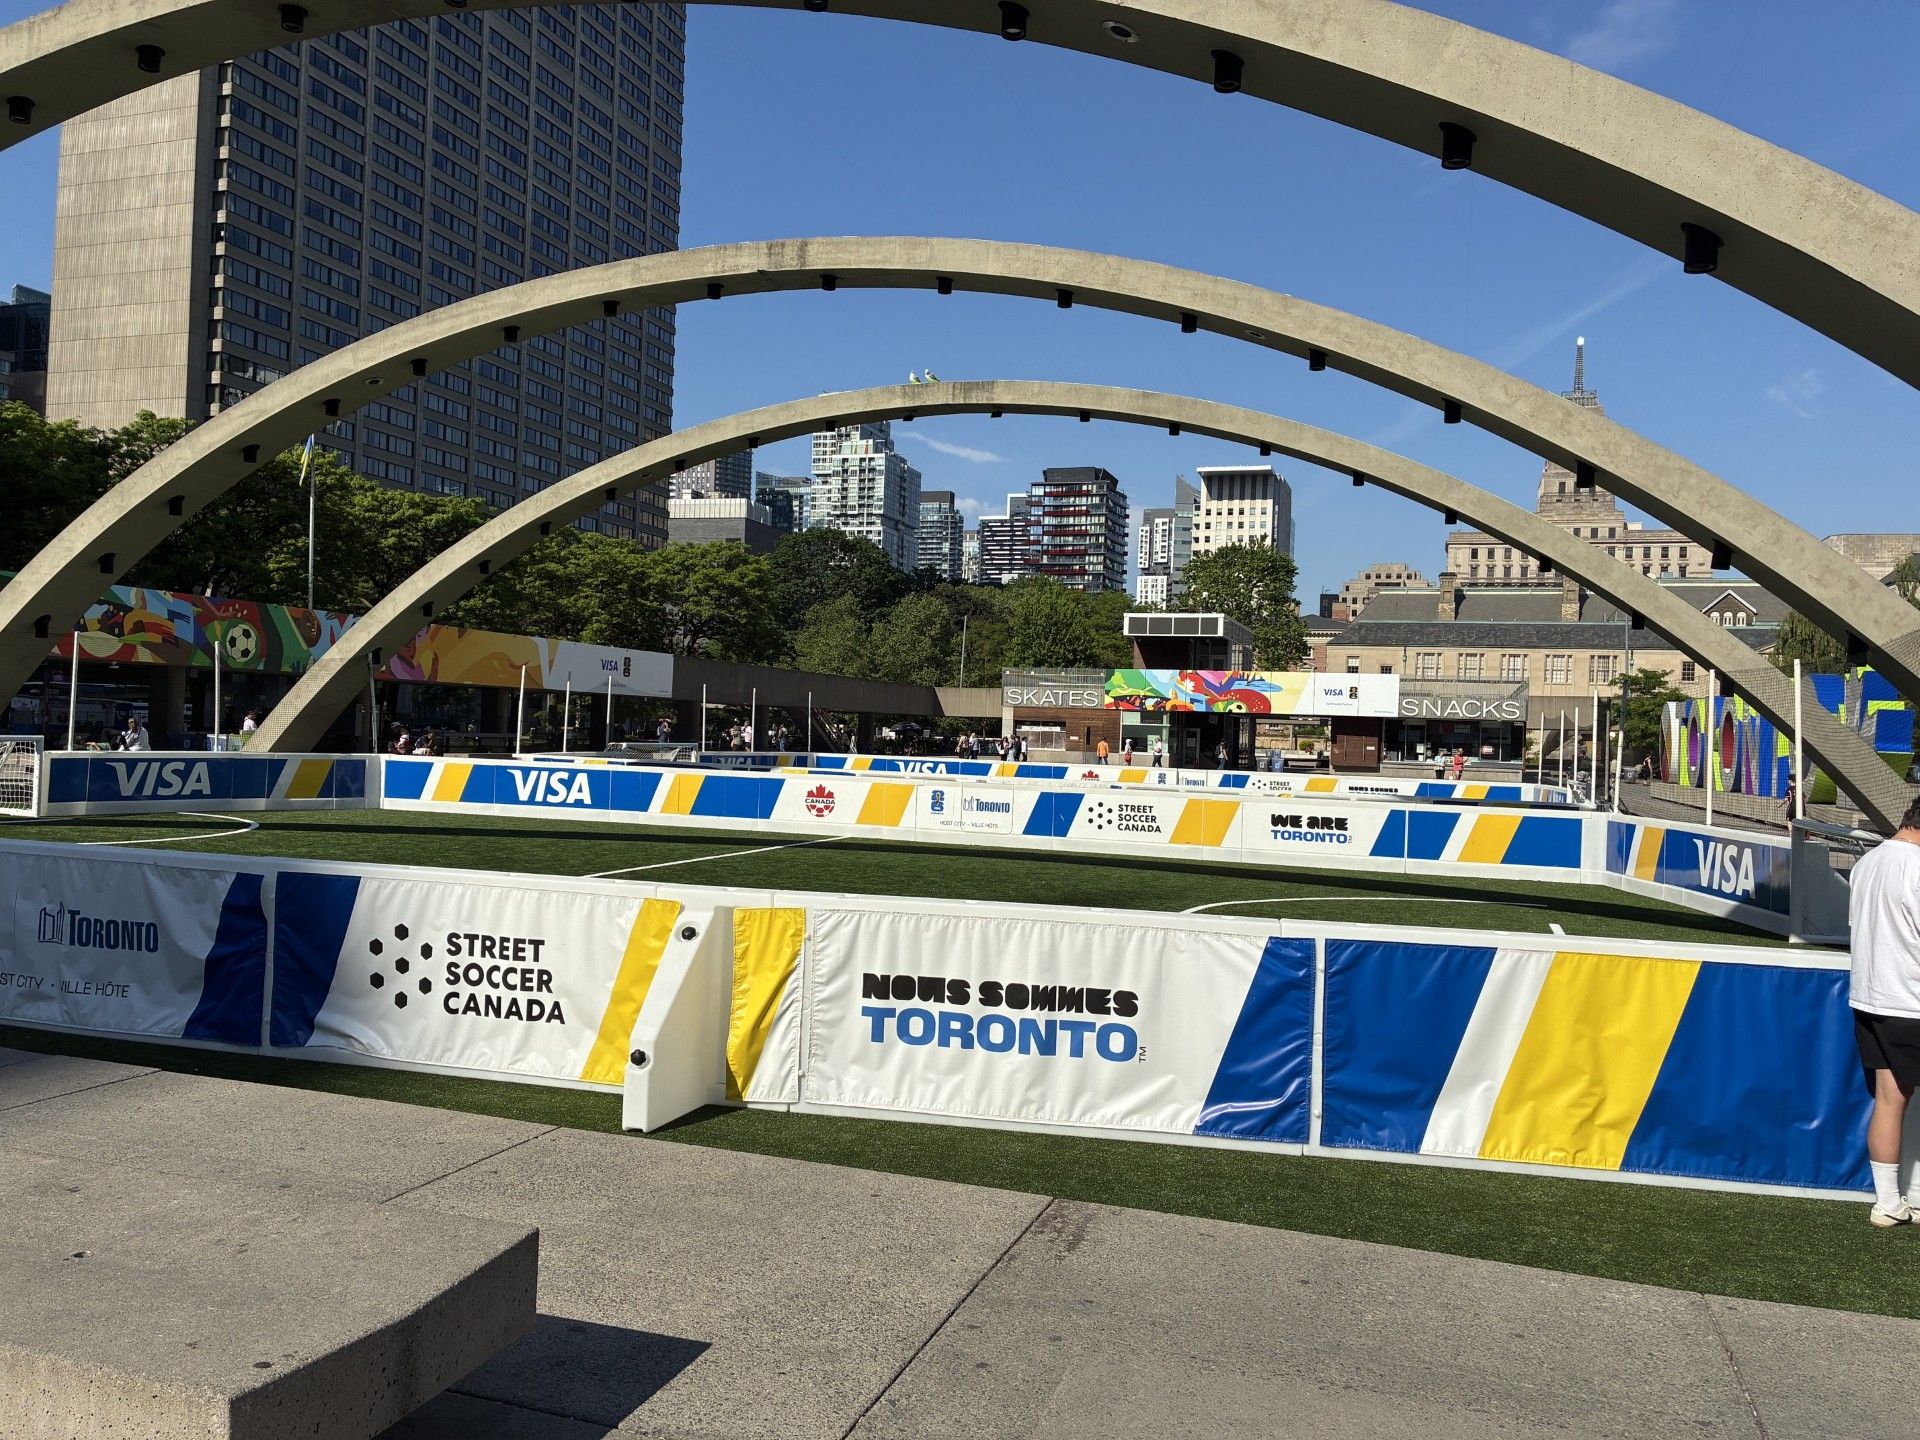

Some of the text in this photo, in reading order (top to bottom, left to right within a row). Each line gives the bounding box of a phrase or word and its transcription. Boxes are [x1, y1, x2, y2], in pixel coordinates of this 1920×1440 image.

[600, 659, 619, 671] VISA
[1006, 688, 1099, 707] SKATES
[1323, 688, 1344, 696] VISA
[1401, 698, 1520, 719] SNACKS
[894, 761, 948, 775] VISA
[105, 761, 212, 797] VISA
[506, 769, 592, 805] VISA
[804, 797, 836, 806] CANADA
[975, 798, 1011, 814] TORONTO
[1117, 804, 1154, 814] STREET
[1117, 814, 1157, 824] SOCCER
[1117, 823, 1162, 834] CANADA
[1270, 813, 1303, 829] WE
[1270, 829, 1348, 844] TORONTO
[1692, 838, 1756, 900] VISA
[67, 909, 160, 953] TORONTO
[445, 932, 546, 963] STREET
[16, 974, 45, 990] CITY
[59, 980, 92, 996] VILLE
[94, 981, 131, 998] HÔTE
[445, 961, 554, 994] SOCCER
[862, 972, 1139, 1018] NOUS SOMMES
[443, 991, 566, 1025] CANADA
[861, 1005, 1138, 1063] TORONTO
